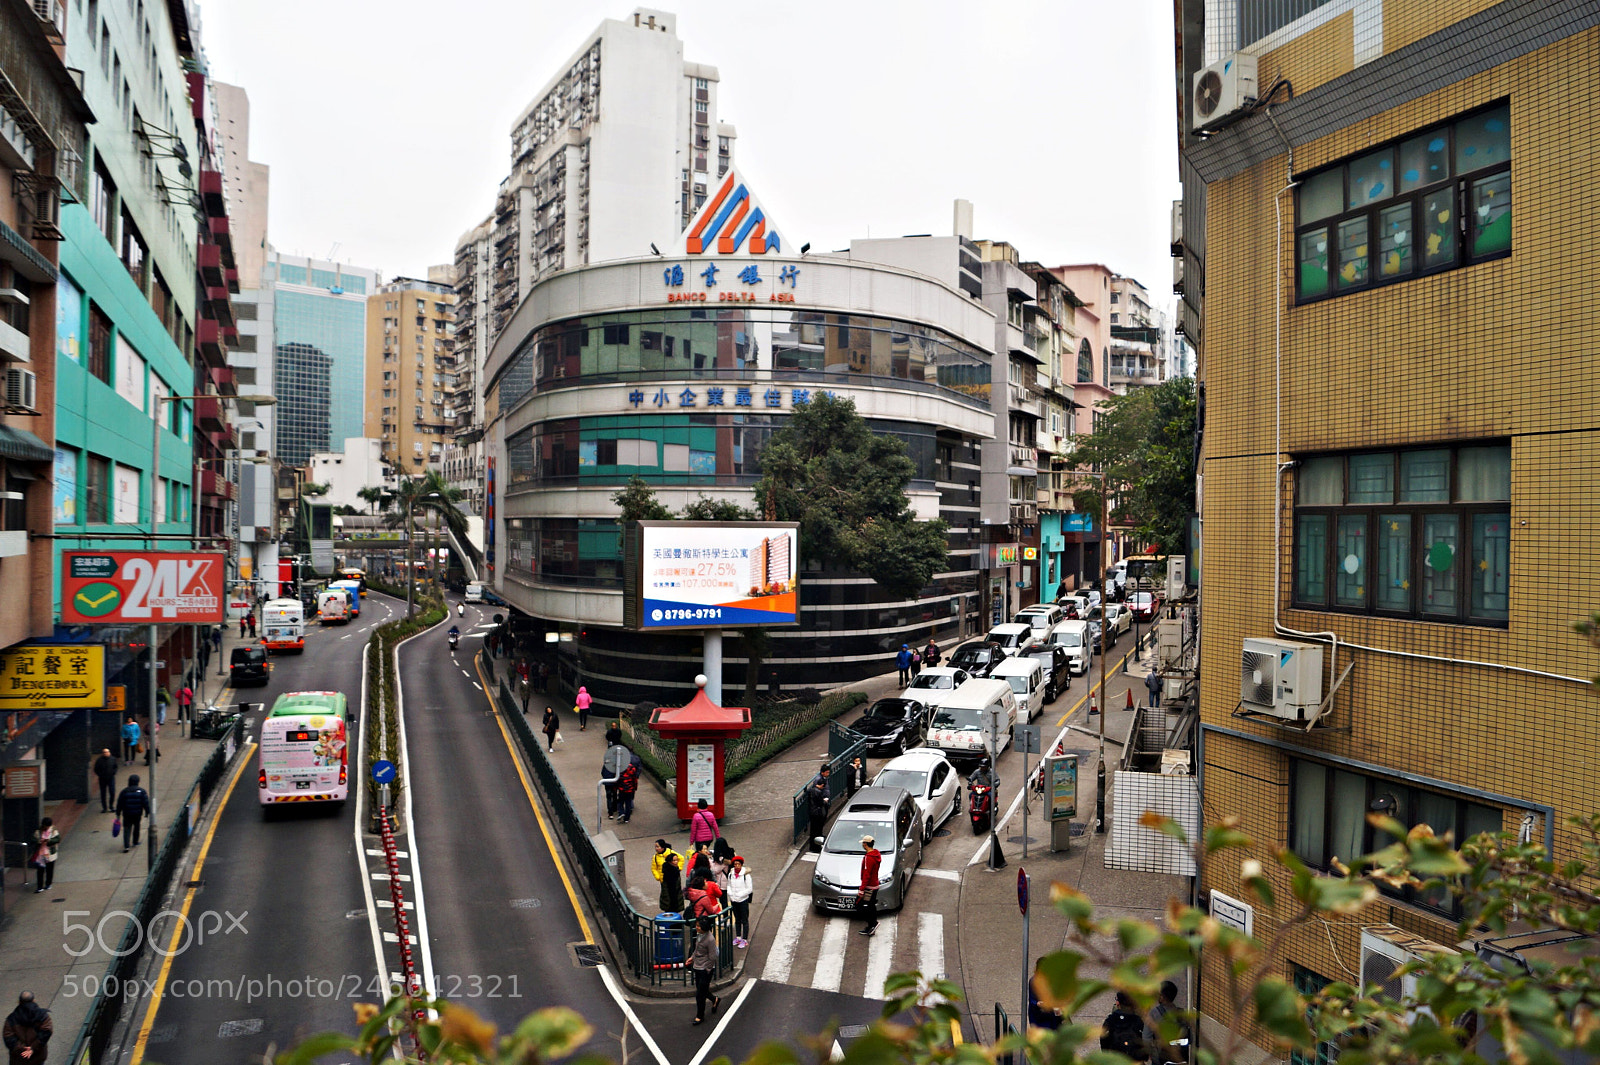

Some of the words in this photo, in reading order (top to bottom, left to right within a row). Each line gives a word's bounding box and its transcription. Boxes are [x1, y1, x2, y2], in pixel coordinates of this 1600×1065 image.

[667, 292, 707, 302] BANCO
[719, 292, 756, 301] DELTA
[769, 293, 796, 302] ASIA
[697, 563, 737, 576] 27.5%
[149, 598, 176, 606] HOURS
[664, 608, 722, 620] 8796-9791
